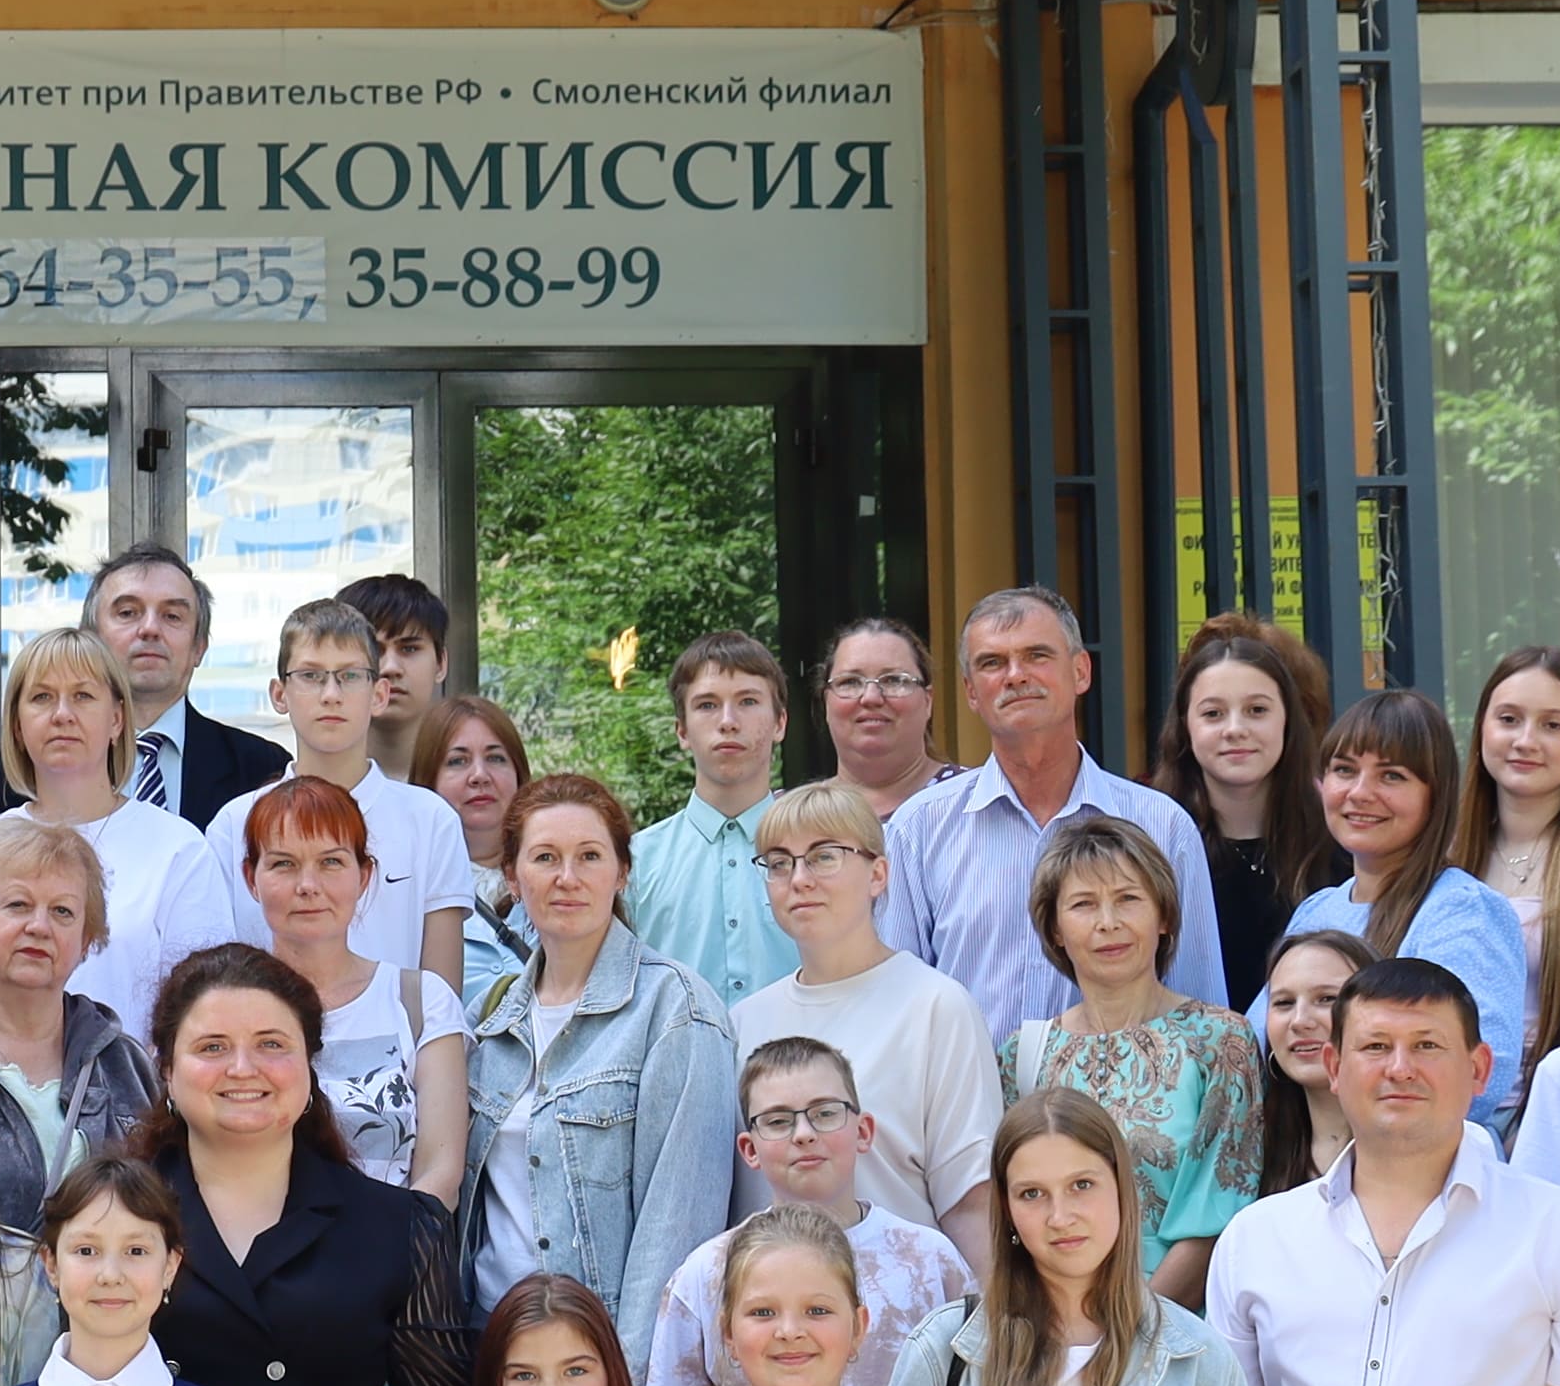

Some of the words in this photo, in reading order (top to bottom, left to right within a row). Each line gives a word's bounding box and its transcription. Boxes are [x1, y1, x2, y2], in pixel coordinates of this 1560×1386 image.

[83, 82, 146, 111] при
[159, 78, 423, 112] Правительстве
[434, 77, 483, 107] РФ
[532, 75, 749, 105] Смоленский
[759, 76, 892, 112] филиал
[256, 139, 894, 212] КОМИССИЯ
[346, 245, 662, 310] 35-88-99
